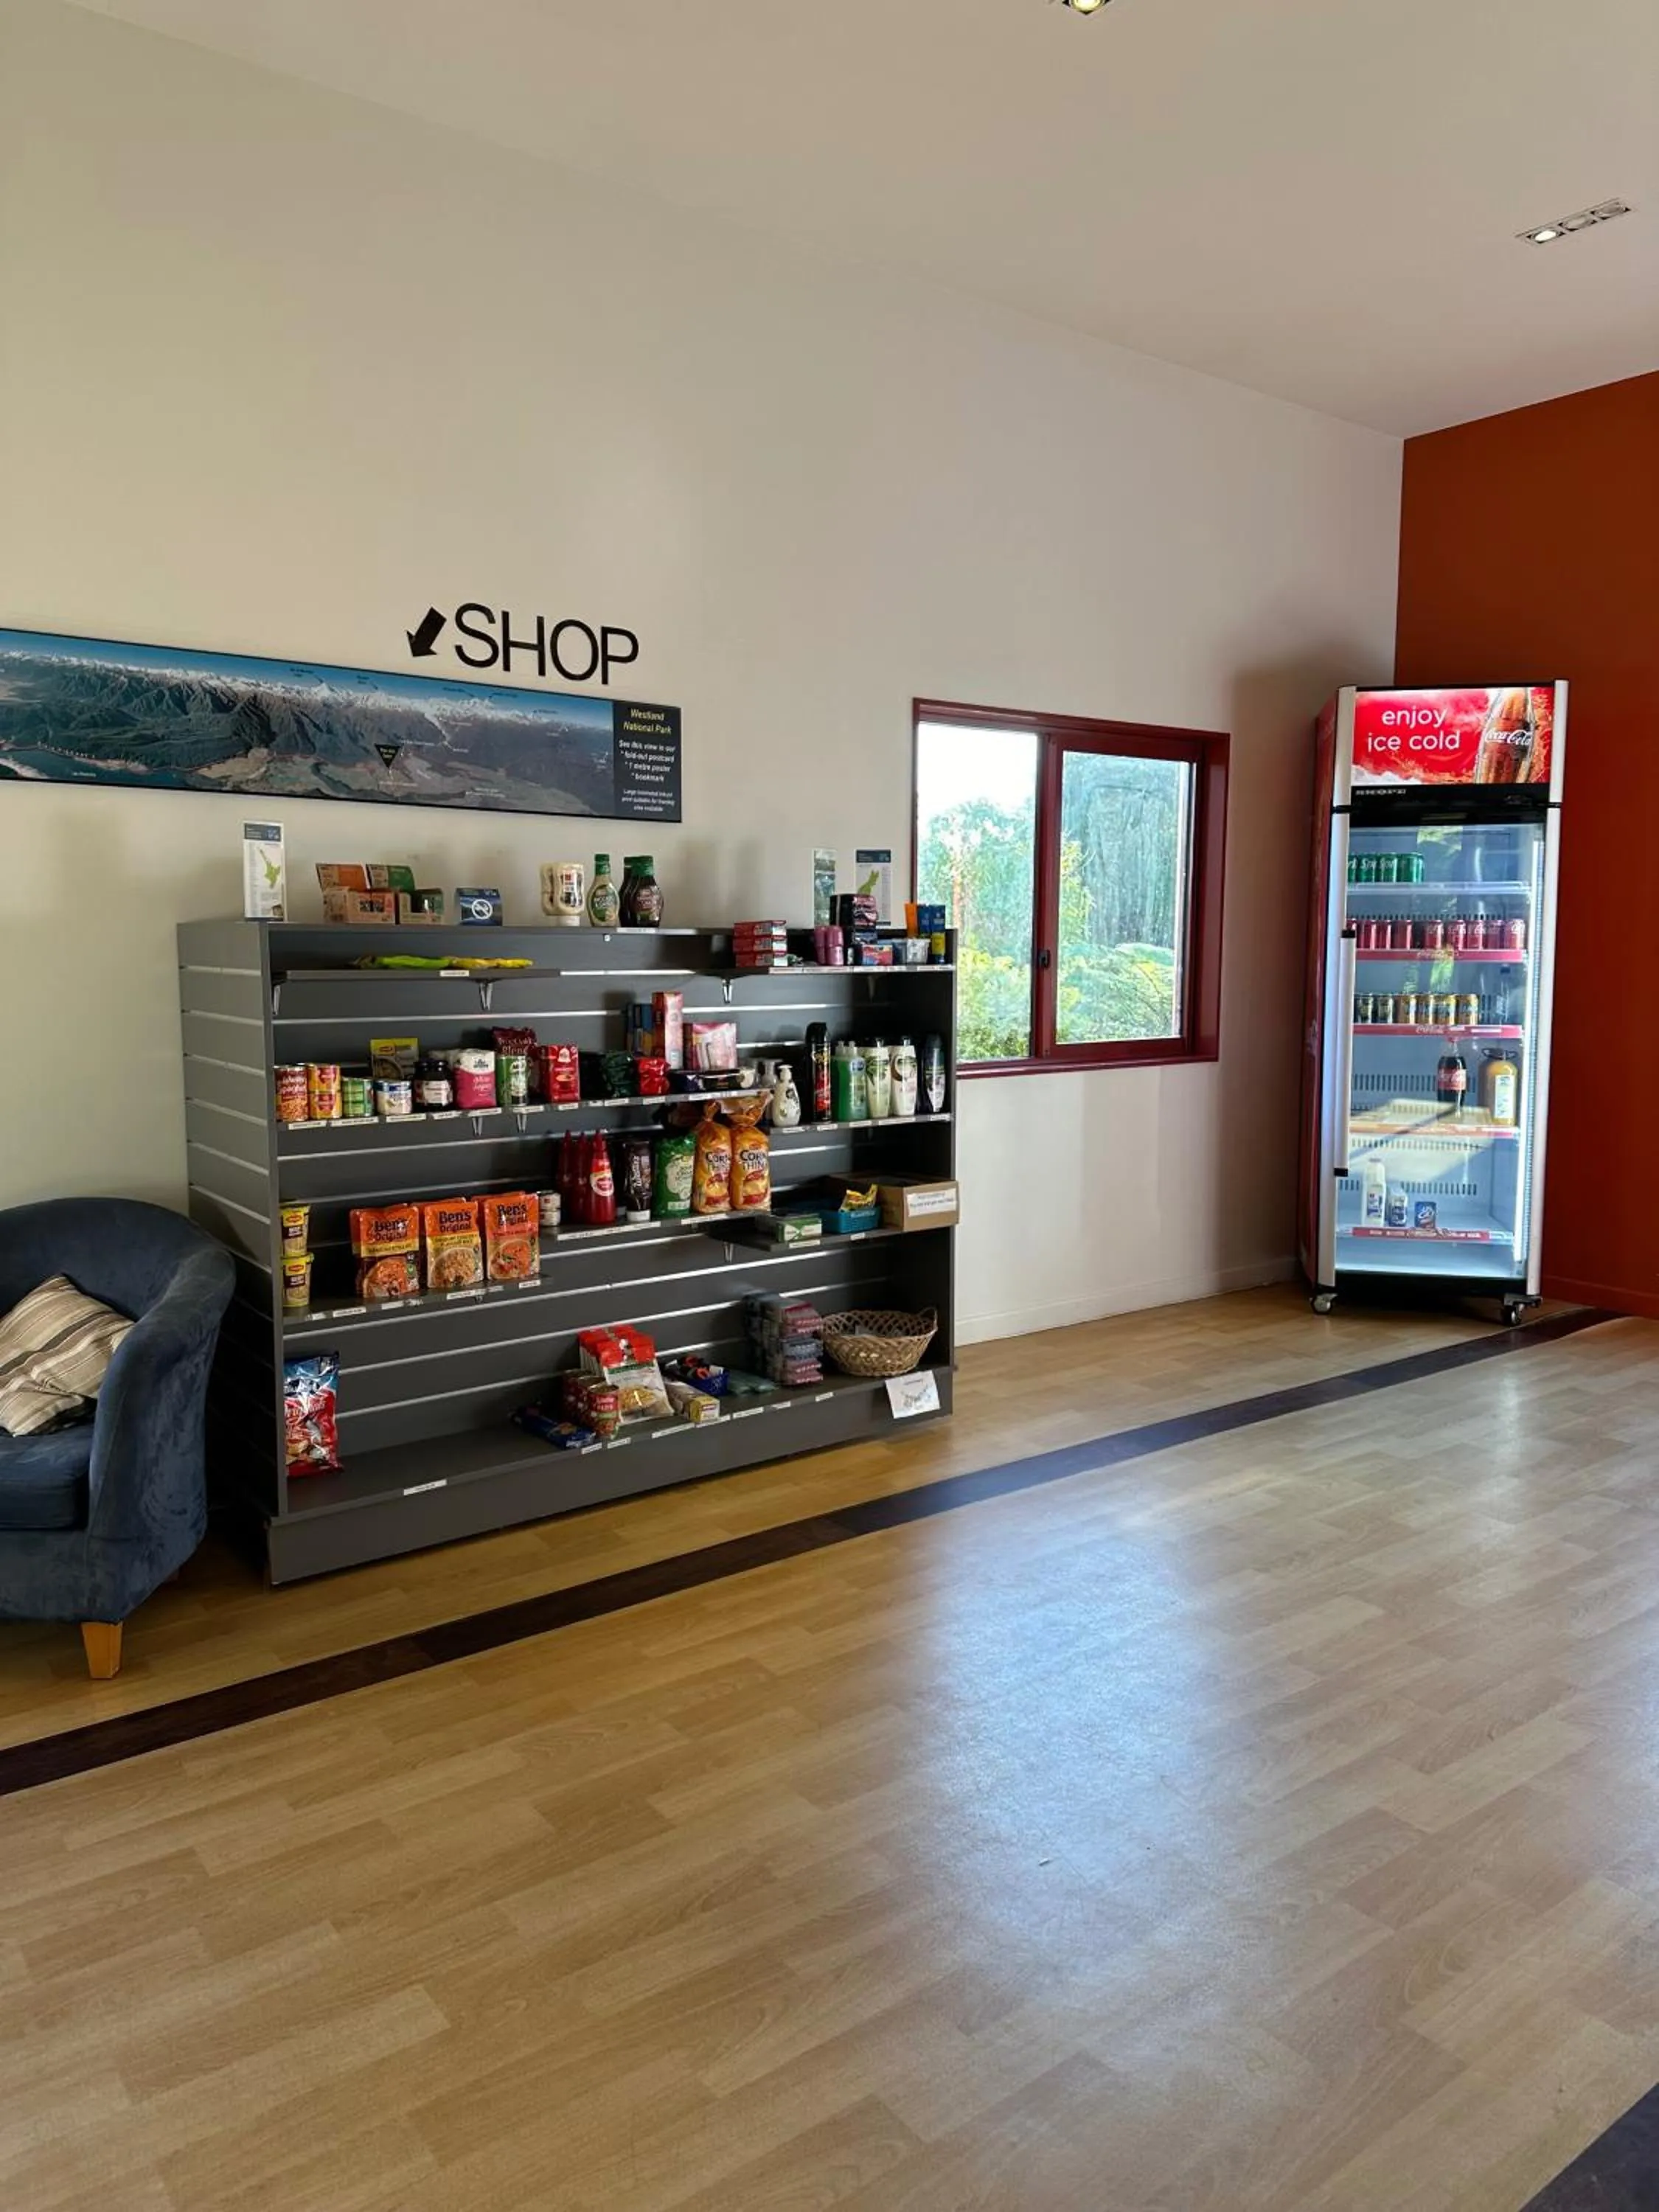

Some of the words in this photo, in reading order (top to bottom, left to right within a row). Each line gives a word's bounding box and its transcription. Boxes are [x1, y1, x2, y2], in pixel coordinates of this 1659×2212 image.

[455, 602, 639, 685] SHOP
[1382, 706, 1447, 728] enjoy
[623, 722, 654, 732] National
[655, 724, 672, 734] Park
[1368, 732, 1401, 751] ice
[1409, 730, 1460, 751] cold
[439, 1209, 472, 1224] Ben's
[497, 1203, 528, 1217] Ben's
